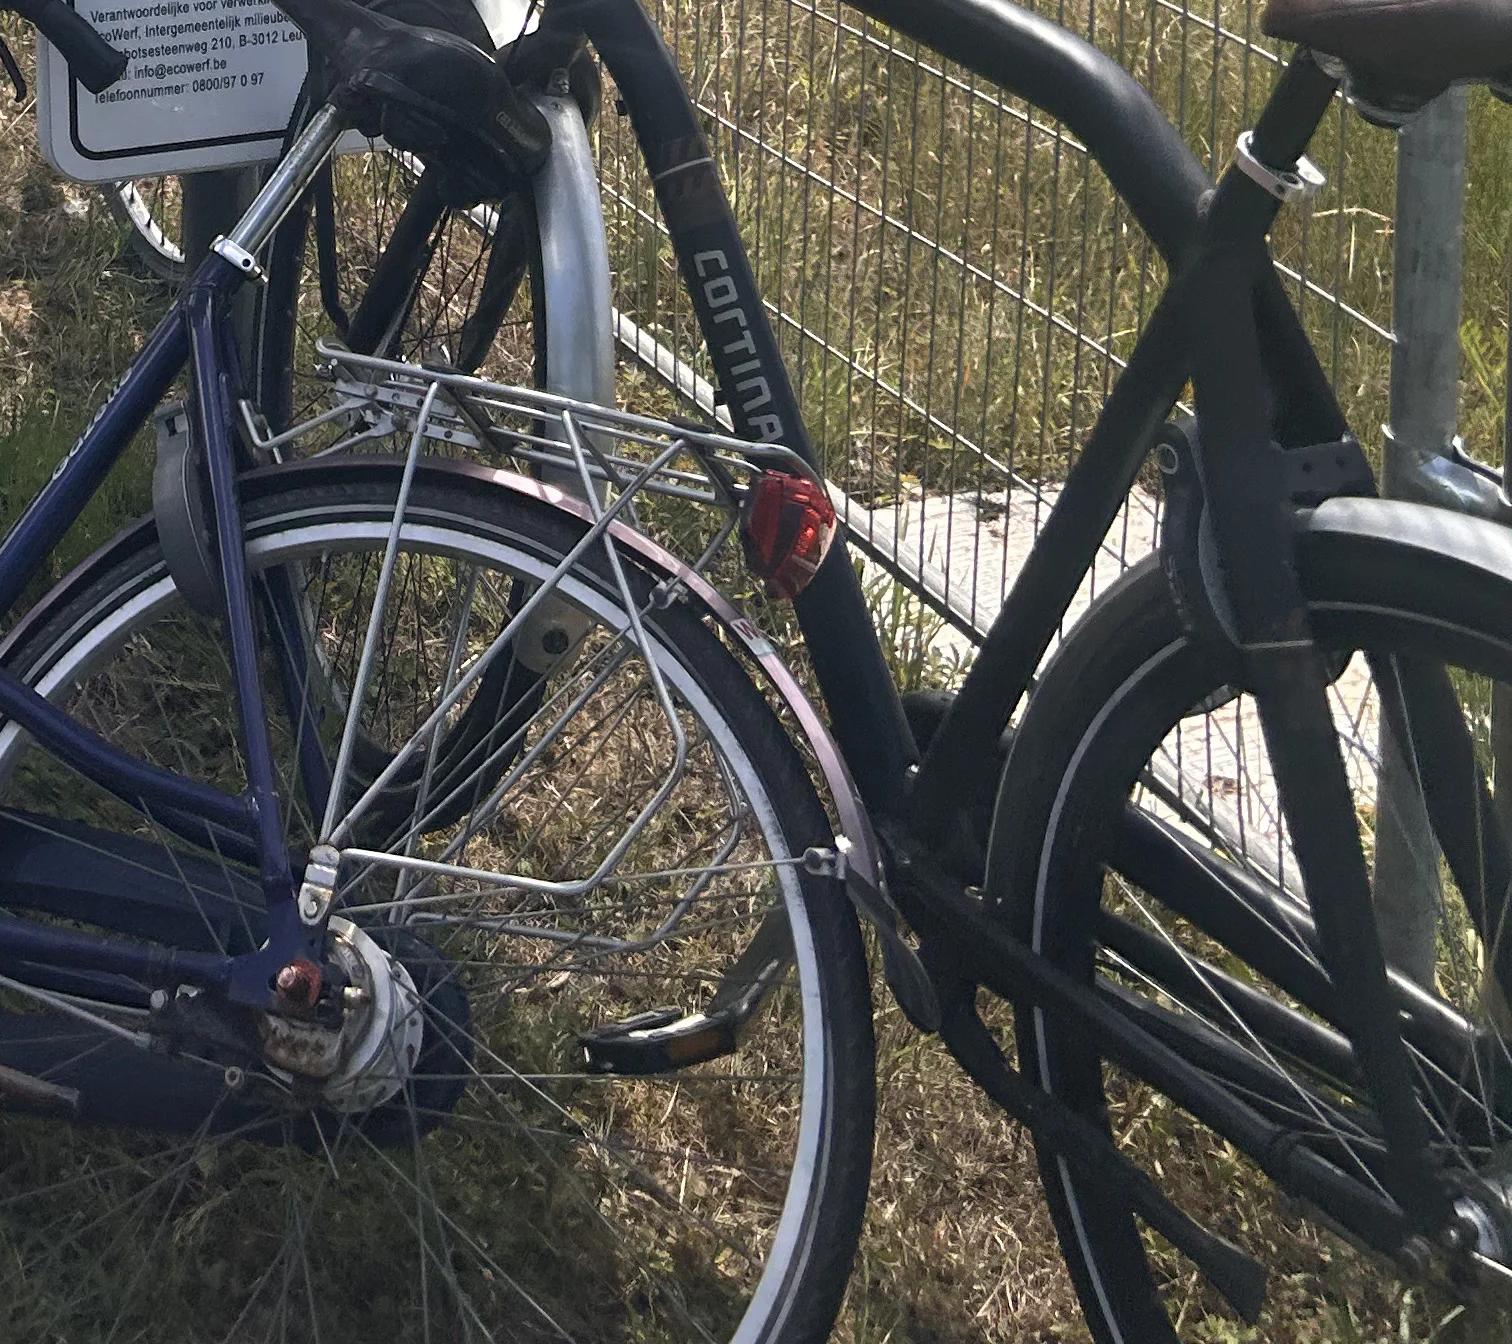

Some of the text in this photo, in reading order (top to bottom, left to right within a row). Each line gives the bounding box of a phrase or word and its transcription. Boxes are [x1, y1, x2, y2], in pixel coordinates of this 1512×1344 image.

[90, 2, 190, 24] Verantwoordelijke
[144, 14, 242, 38] Intergemeentelijk
[211, 36, 236, 51] 210,
[133, 59, 227, 80] info@ecowerf.be
[192, 75, 237, 92] 0800/97
[240, 74, 248, 88] 0
[250, 72, 265, 86] 97
